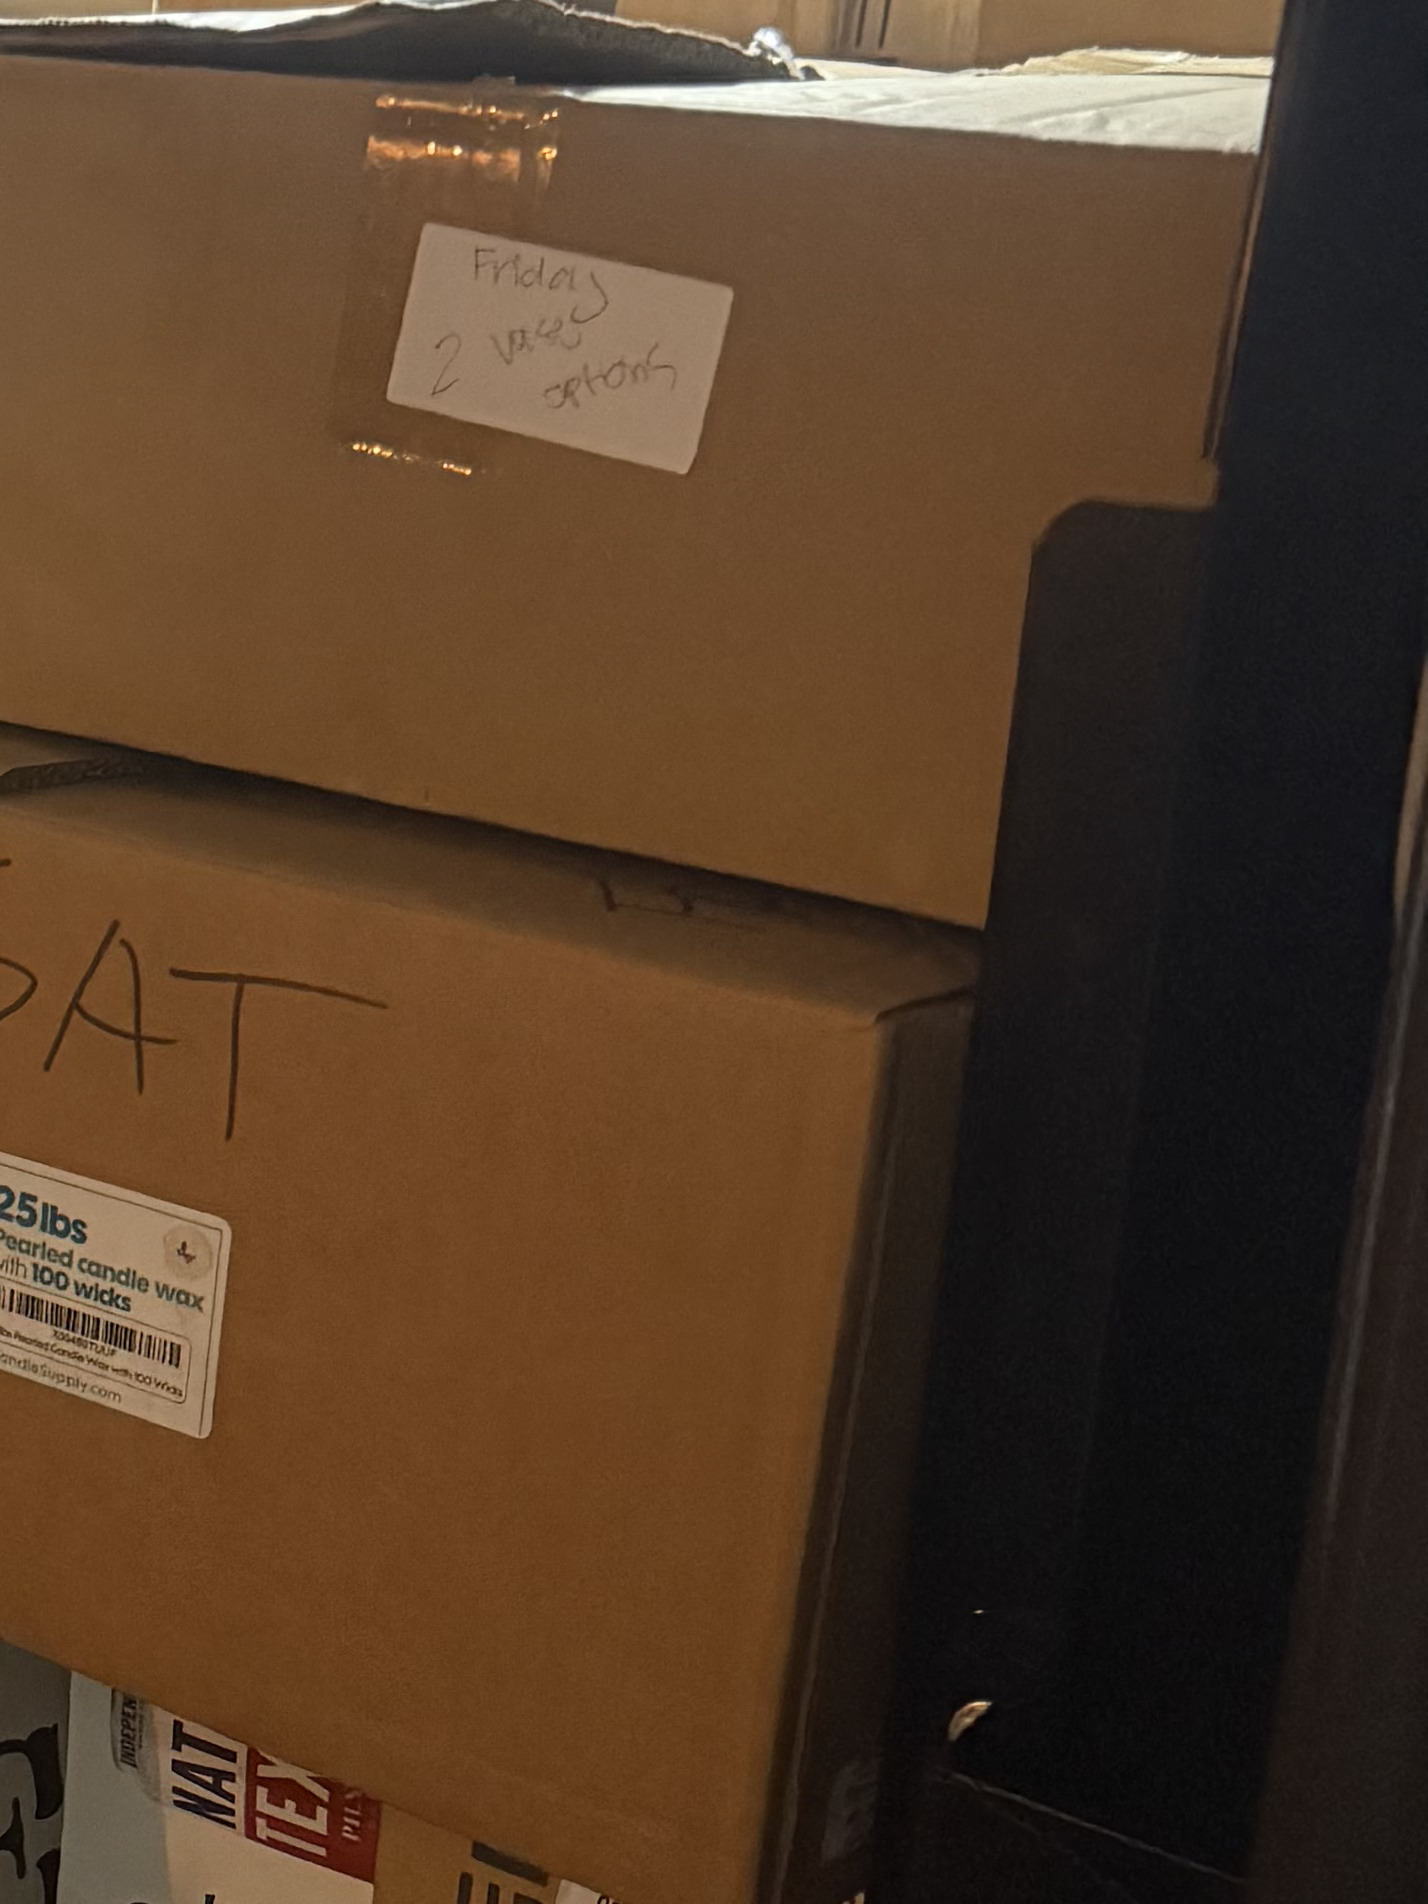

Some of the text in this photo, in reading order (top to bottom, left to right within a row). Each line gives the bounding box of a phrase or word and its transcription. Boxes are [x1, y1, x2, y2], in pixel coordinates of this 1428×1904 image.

[432, 331, 462, 397] 2
[30, 1263, 71, 1293] 100
[72, 1273, 133, 1314] wicks
[77, 1256, 149, 1294] candle
[153, 1279, 206, 1315] wax
[118, 1698, 139, 1770] INDEPEN
[171, 1718, 238, 1831] NAT
[255, 1746, 331, 1858] TEX
